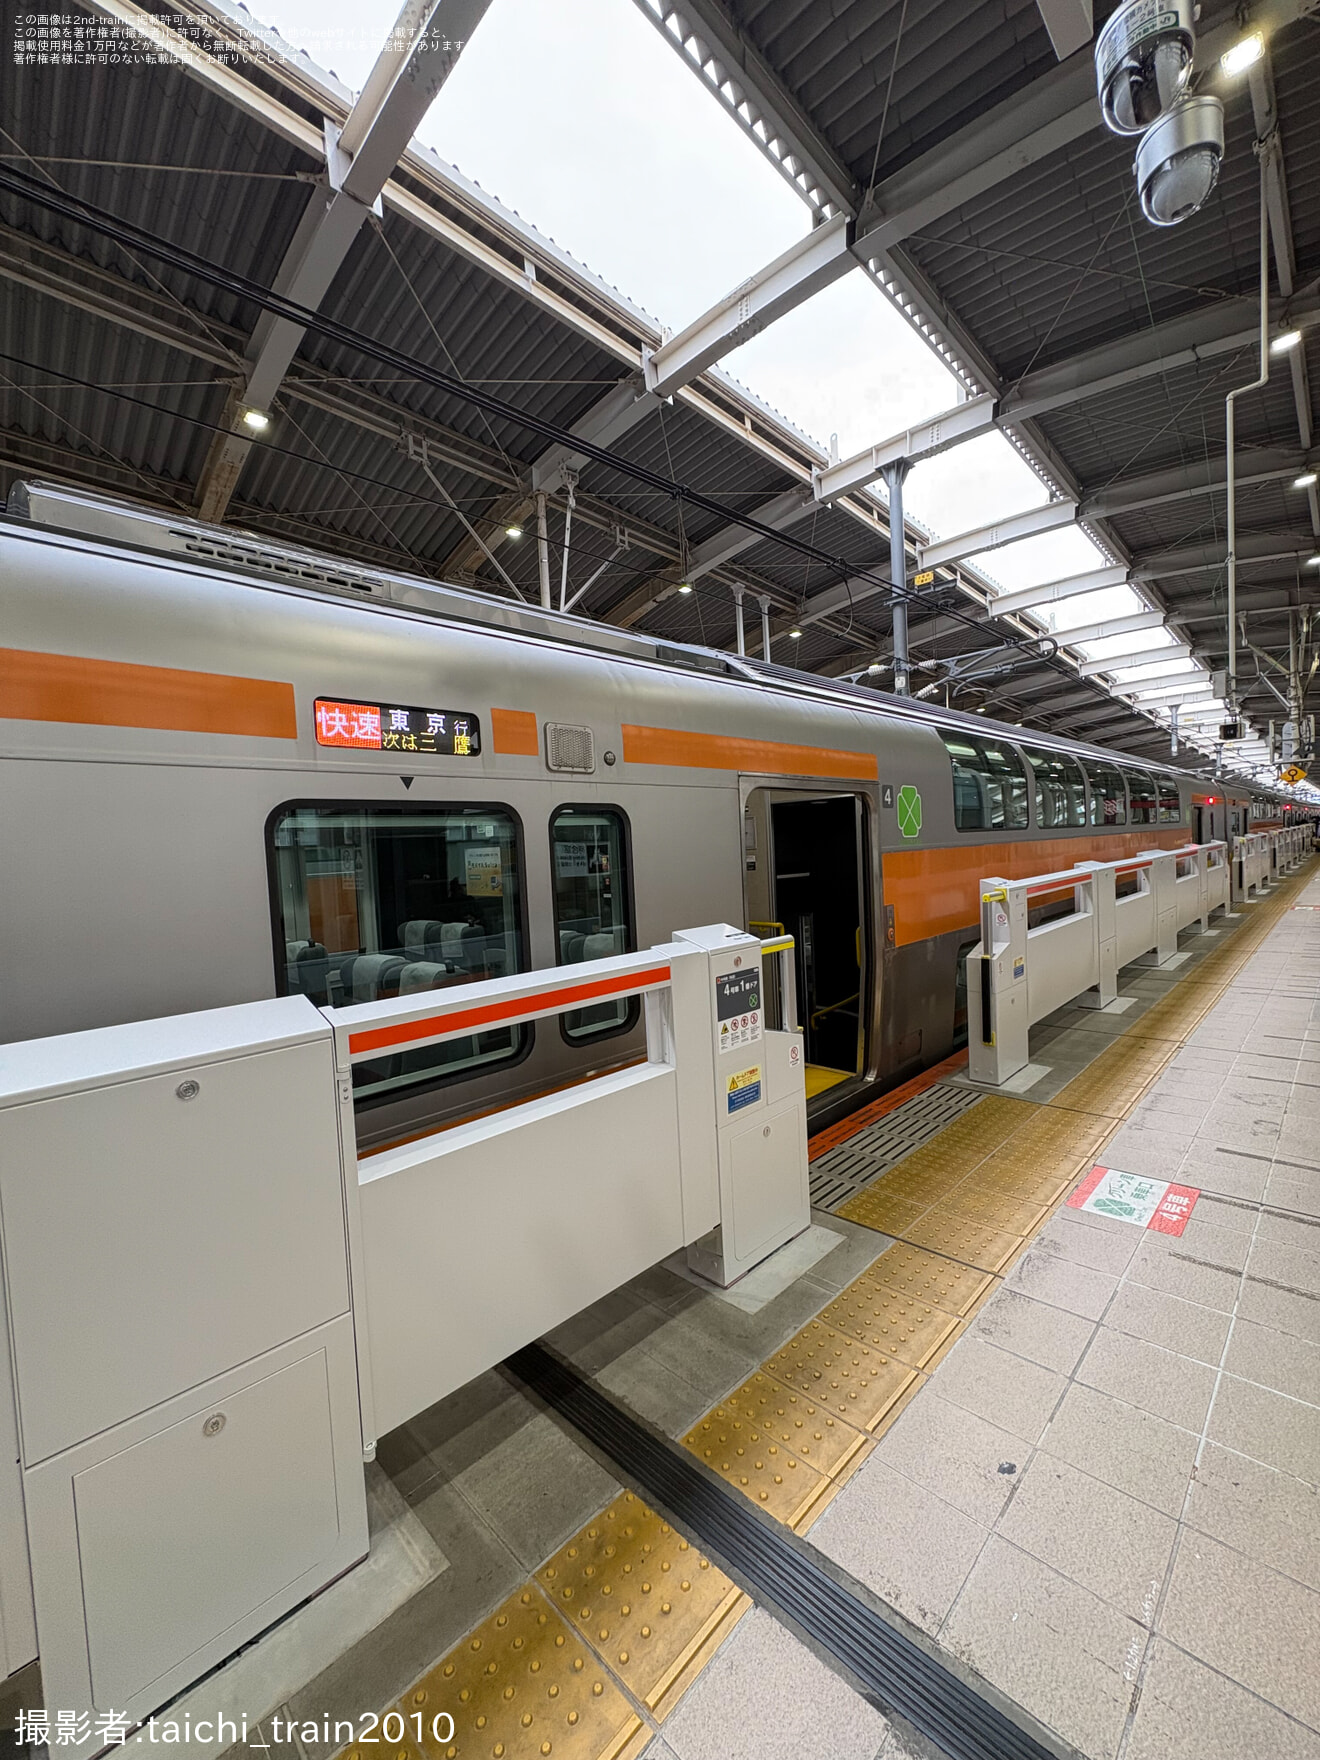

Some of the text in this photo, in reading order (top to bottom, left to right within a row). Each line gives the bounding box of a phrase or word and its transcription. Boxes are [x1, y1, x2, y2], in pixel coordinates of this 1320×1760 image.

[317, 706, 381, 740] 快速
[382, 731, 471, 755] 次は三鷹
[884, 788, 892, 805] 4
[1159, 1193, 1191, 1221] 4号車
